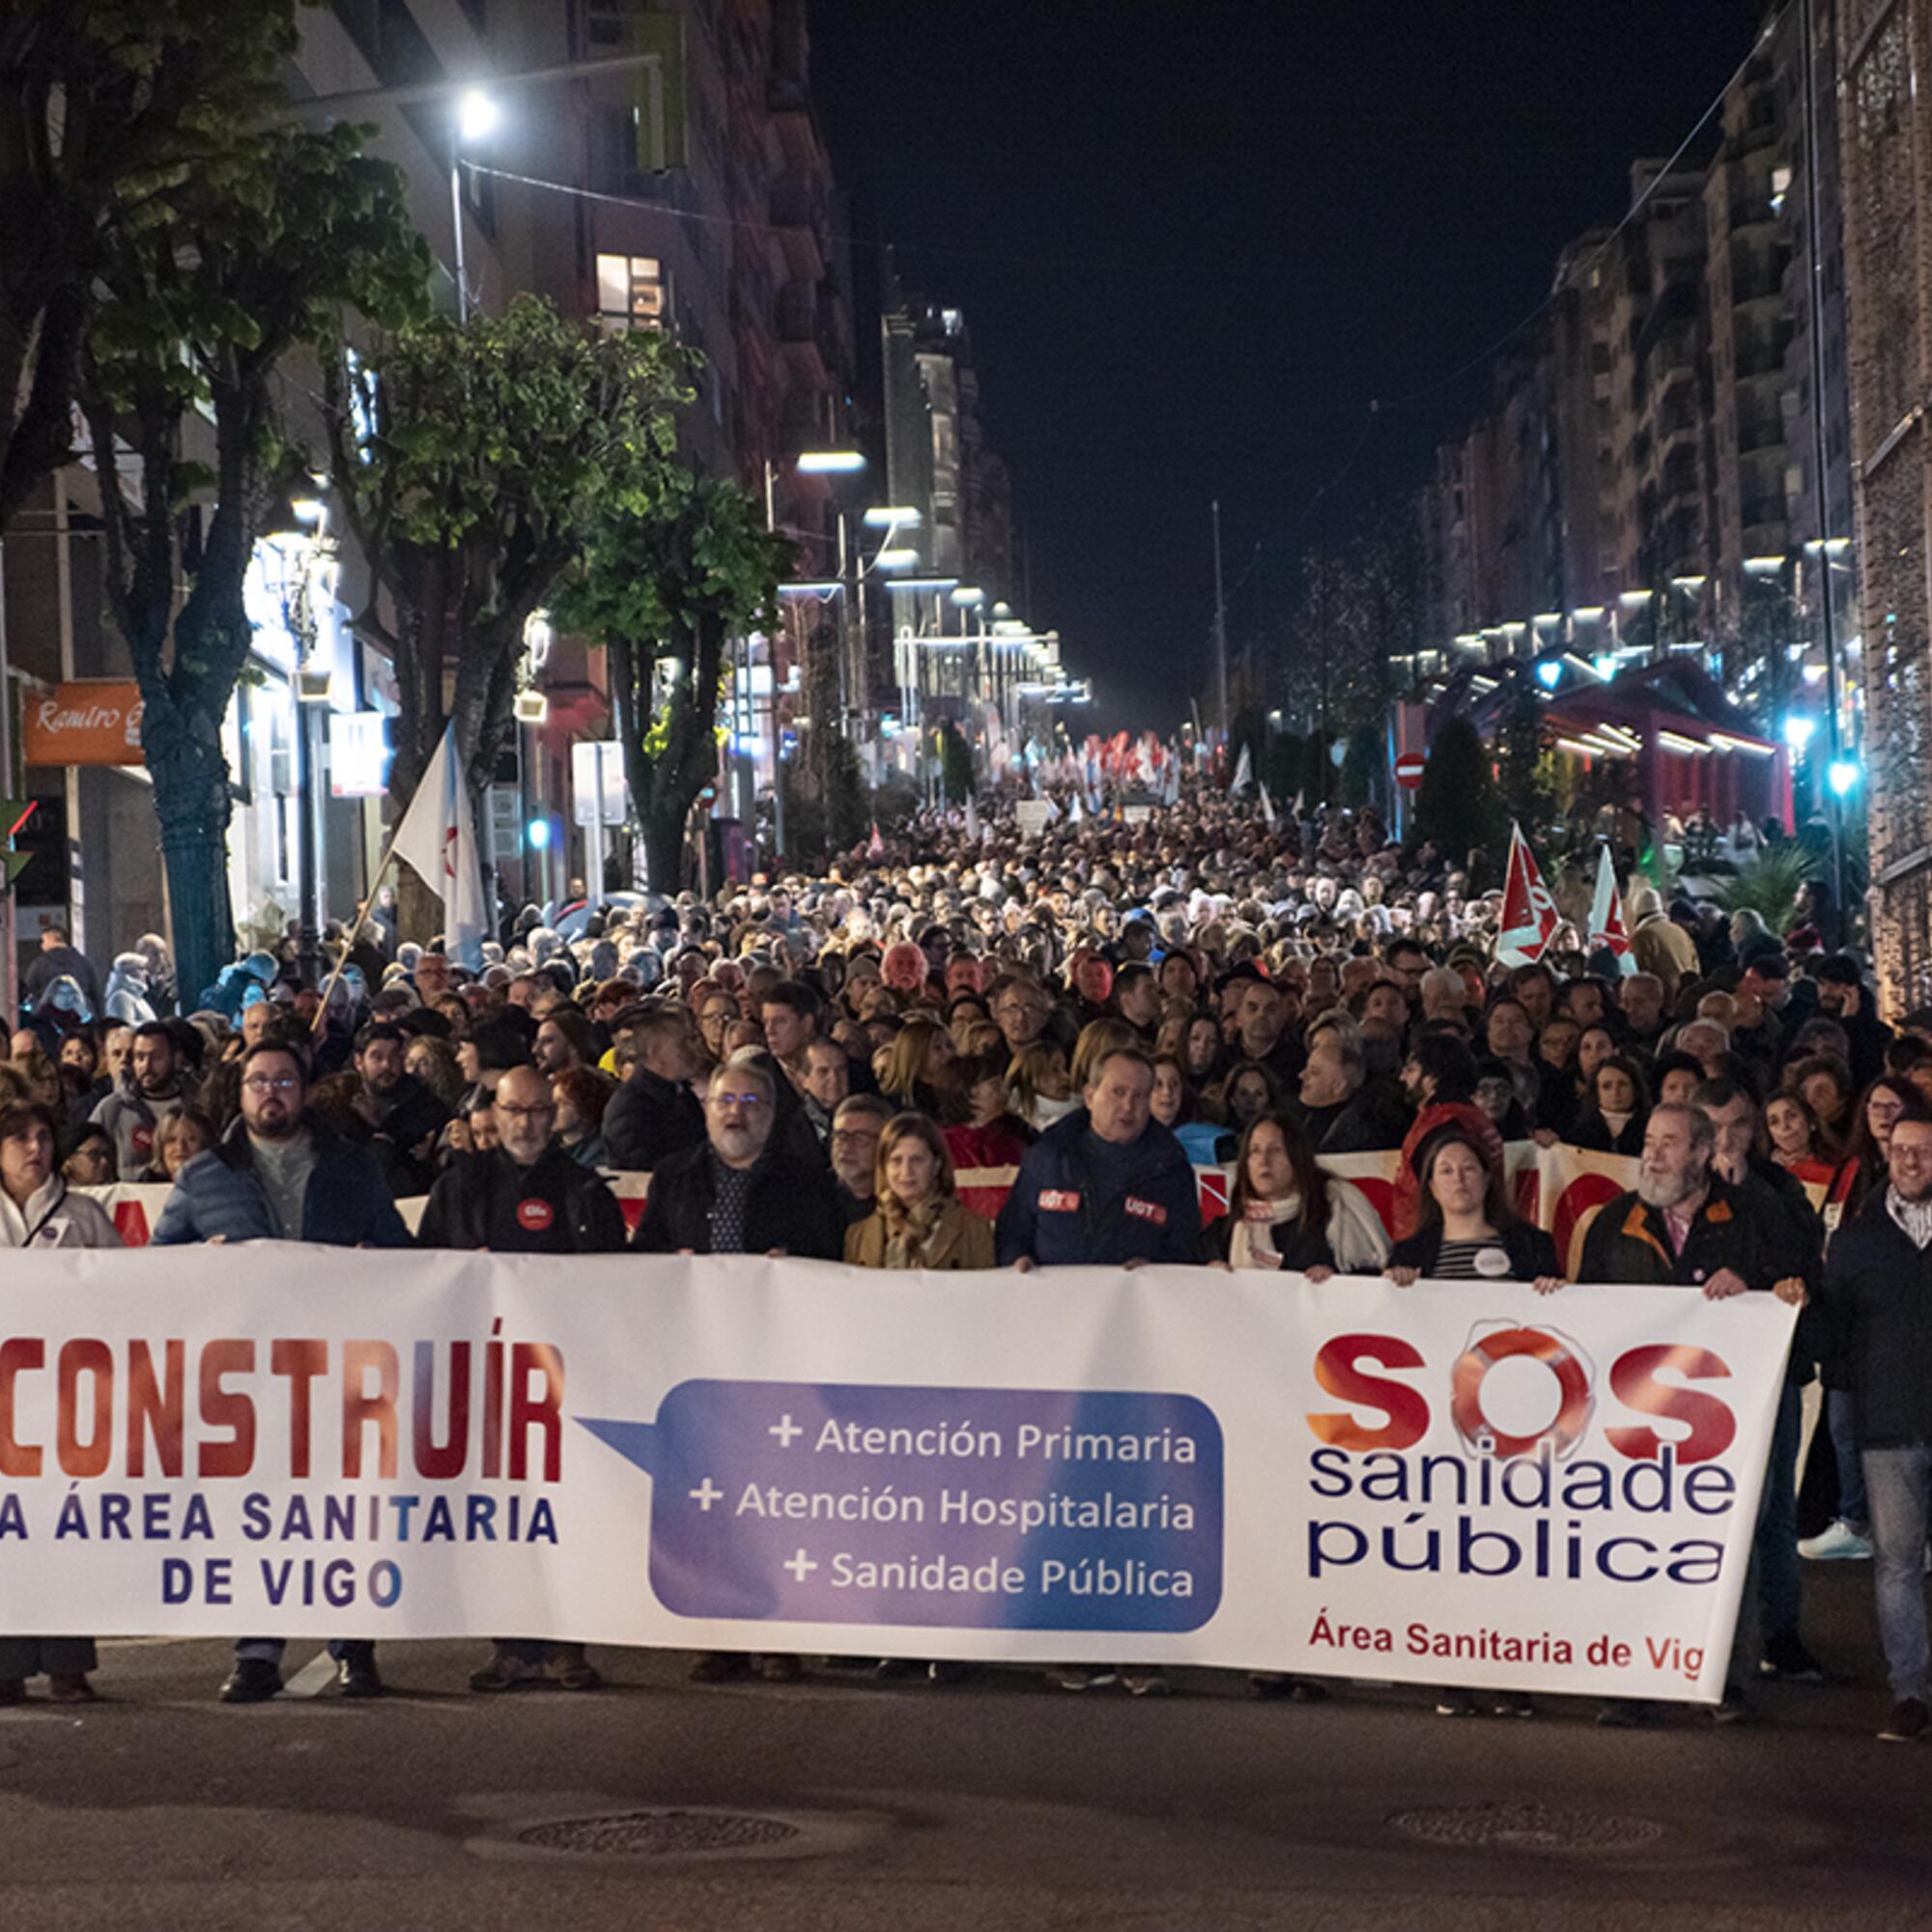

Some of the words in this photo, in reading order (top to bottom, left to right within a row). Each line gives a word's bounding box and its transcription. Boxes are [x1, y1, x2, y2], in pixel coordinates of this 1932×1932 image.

[36, 700, 122, 732] Ramiro
[1125, 1196, 1156, 1217] UGT
[0, 1317, 565, 1483] CONSTRUÍR
[1306, 1321, 1737, 1465] SOS
[815, 1418, 1002, 1458] Atención
[1017, 1424, 1196, 1463] Primaria
[1309, 1439, 1737, 1516] sanidade
[0, 1493, 28, 1540] A
[54, 1480, 214, 1541] ÁREA
[242, 1492, 559, 1545] SANITARIA
[735, 1483, 924, 1523] Atención
[939, 1489, 1195, 1535] Hospitalaria
[831, 1551, 1025, 1594] Sanidade
[1041, 1557, 1194, 1597] Pública
[1308, 1512, 1725, 1585] pública
[162, 1558, 233, 1605] DE
[260, 1557, 403, 1608] VIGO
[1309, 1607, 1393, 1652] Área
[1406, 1622, 1573, 1665] Sanitaria
[1586, 1634, 1632, 1667] de
